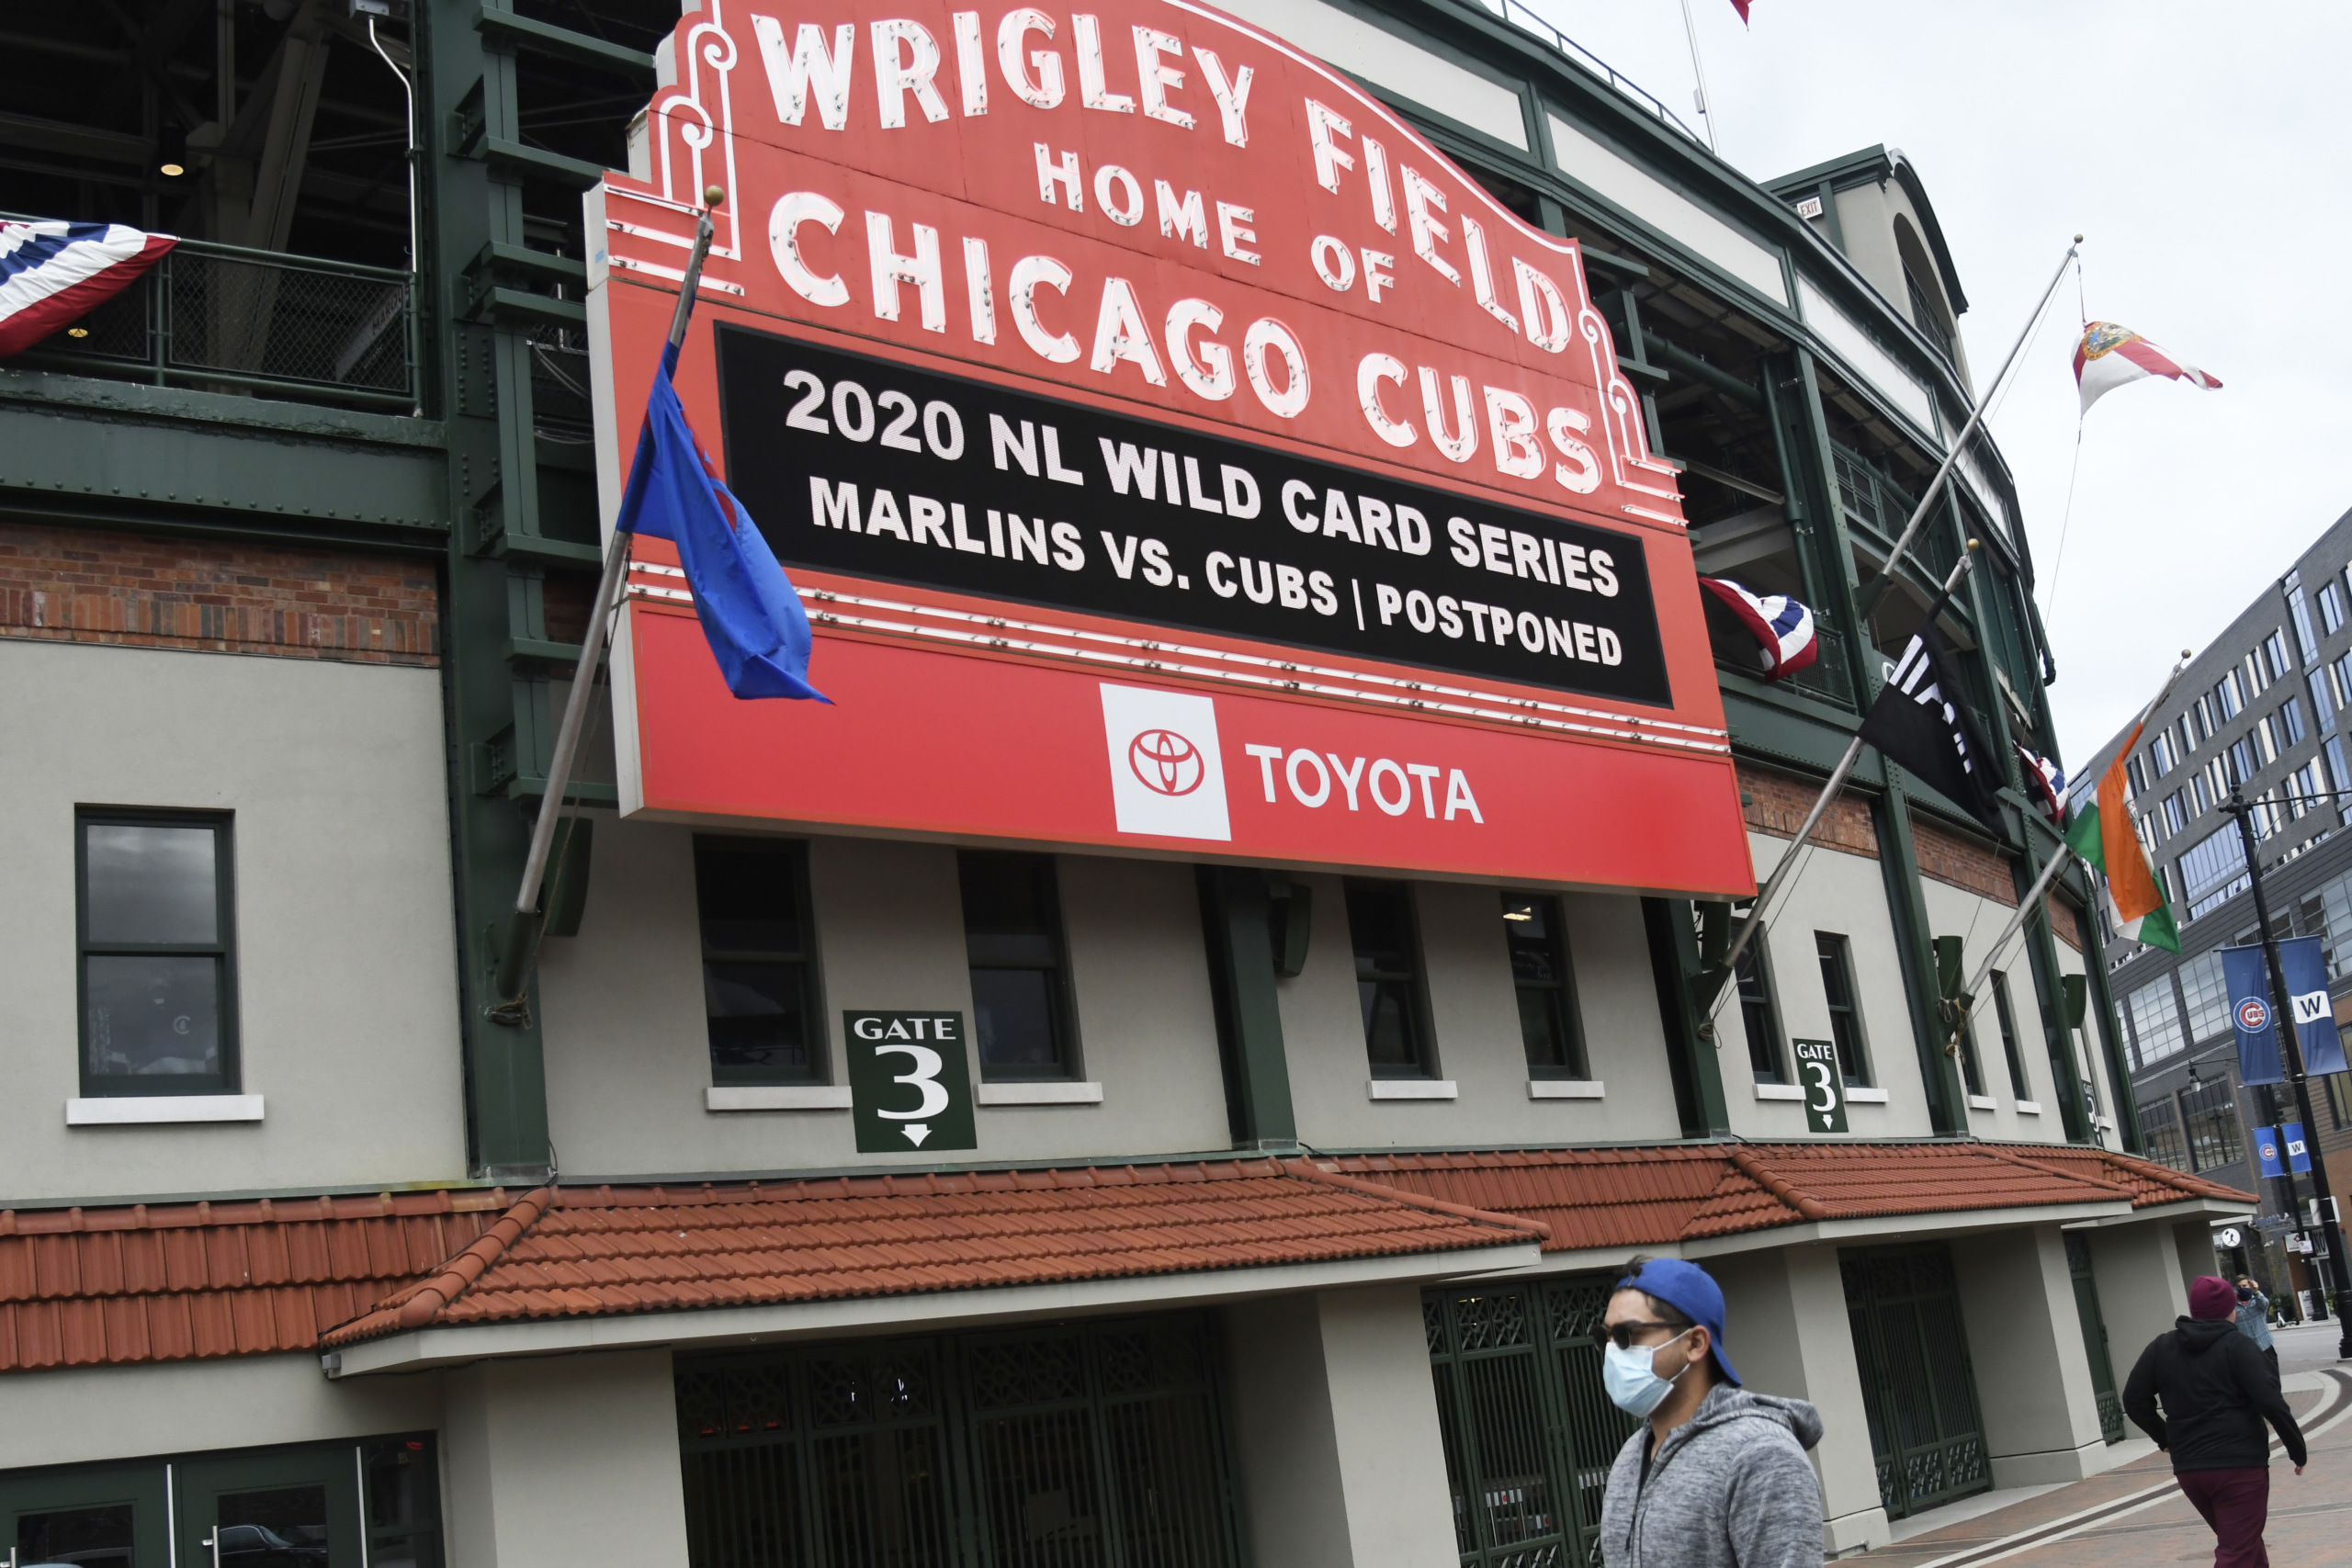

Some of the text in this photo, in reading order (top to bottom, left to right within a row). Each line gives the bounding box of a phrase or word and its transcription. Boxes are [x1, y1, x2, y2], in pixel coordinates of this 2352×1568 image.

[751, 8, 1571, 353] WRIGLEY FIELD
[1801, 201, 1817, 216] EXIT
[1035, 142, 1395, 302] HOME OF
[768, 192, 1602, 493] CHICAGO CUBS
[784, 369, 1619, 597] 2020 NL WILD CARD SERIES
[809, 476, 1086, 572] MARLINS
[1101, 530, 1191, 590] VS.
[1205, 551, 1339, 616] CUBS
[1376, 583, 1623, 666] POSTPONED
[1245, 743, 1484, 824] TOYOTA
[854, 1018, 956, 1040] GATE
[2300, 995, 2321, 1018] W
[875, 1044, 949, 1120] 3
[1796, 1043, 1833, 1060] GATE
[1806, 1062, 1837, 1111] 3
[2291, 1143, 2301, 1153] W
